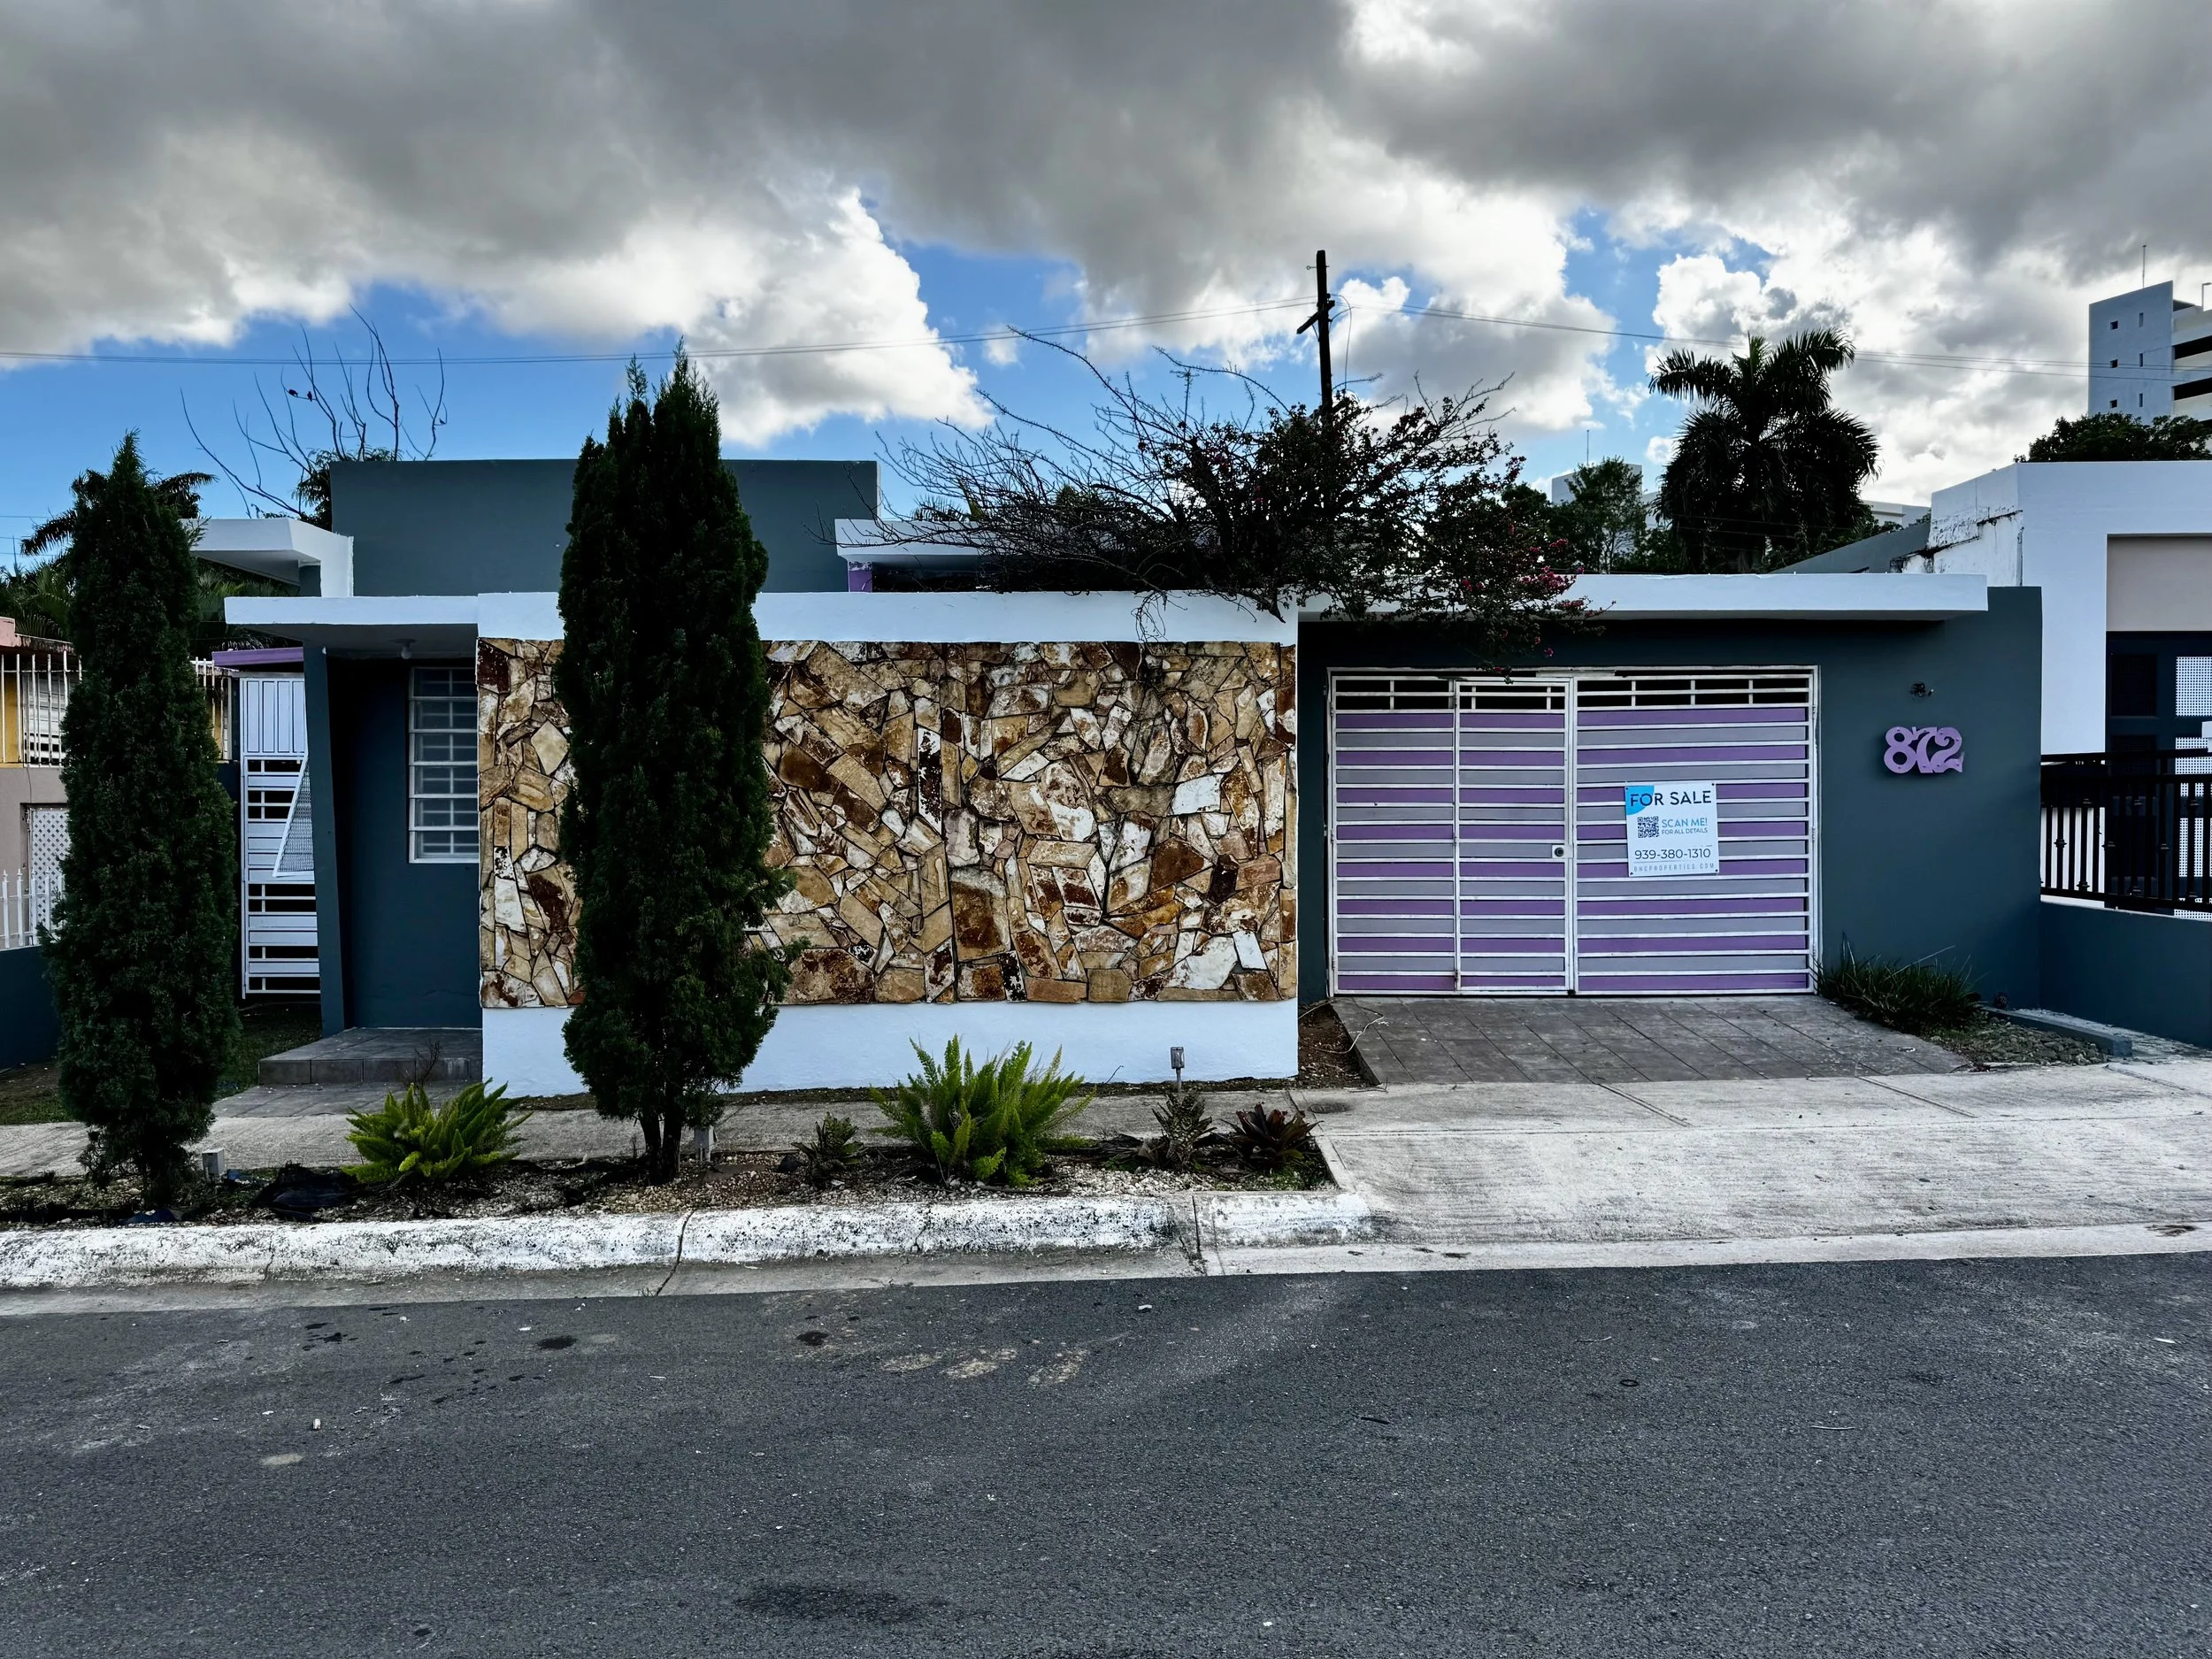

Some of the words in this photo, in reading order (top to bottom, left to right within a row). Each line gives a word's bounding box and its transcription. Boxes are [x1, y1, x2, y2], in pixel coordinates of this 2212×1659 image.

[1883, 726, 1965, 774] 872
[1630, 793, 1664, 807] FOR
[1670, 790, 1712, 805] SALE
[1661, 818, 1688, 828] SCAN
[1690, 817, 1708, 826] ME!
[1634, 848, 1711, 860] 939-380-1310
